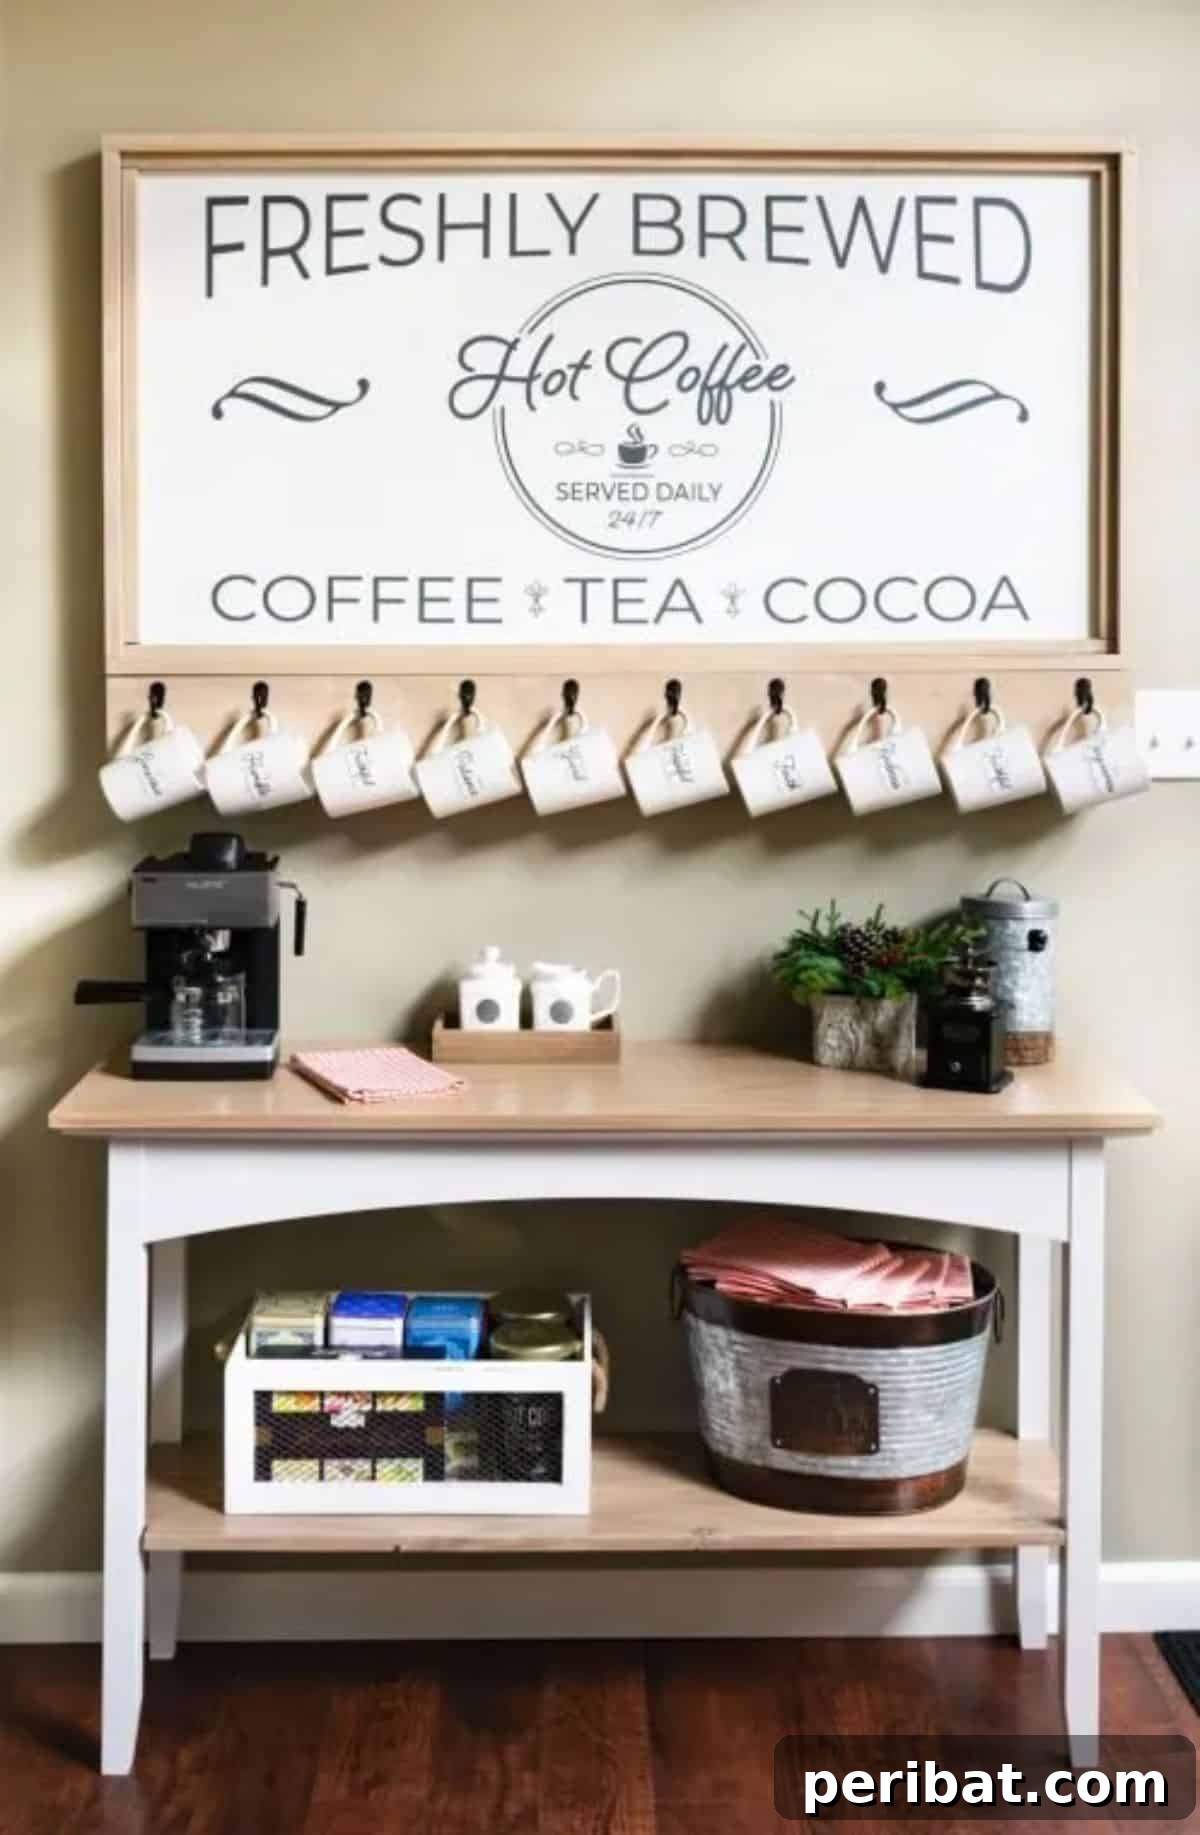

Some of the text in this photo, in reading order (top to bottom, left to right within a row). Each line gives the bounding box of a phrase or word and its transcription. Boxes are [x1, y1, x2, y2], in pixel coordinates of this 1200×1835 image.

[203, 191, 1033, 299] FRESHLY BREWED
[448, 330, 796, 426] Hot Coffee
[555, 481, 723, 502] SERVED DAILY
[607, 509, 664, 530] 24/7
[210, 573, 1030, 626] COFFEE TEA COCOA
